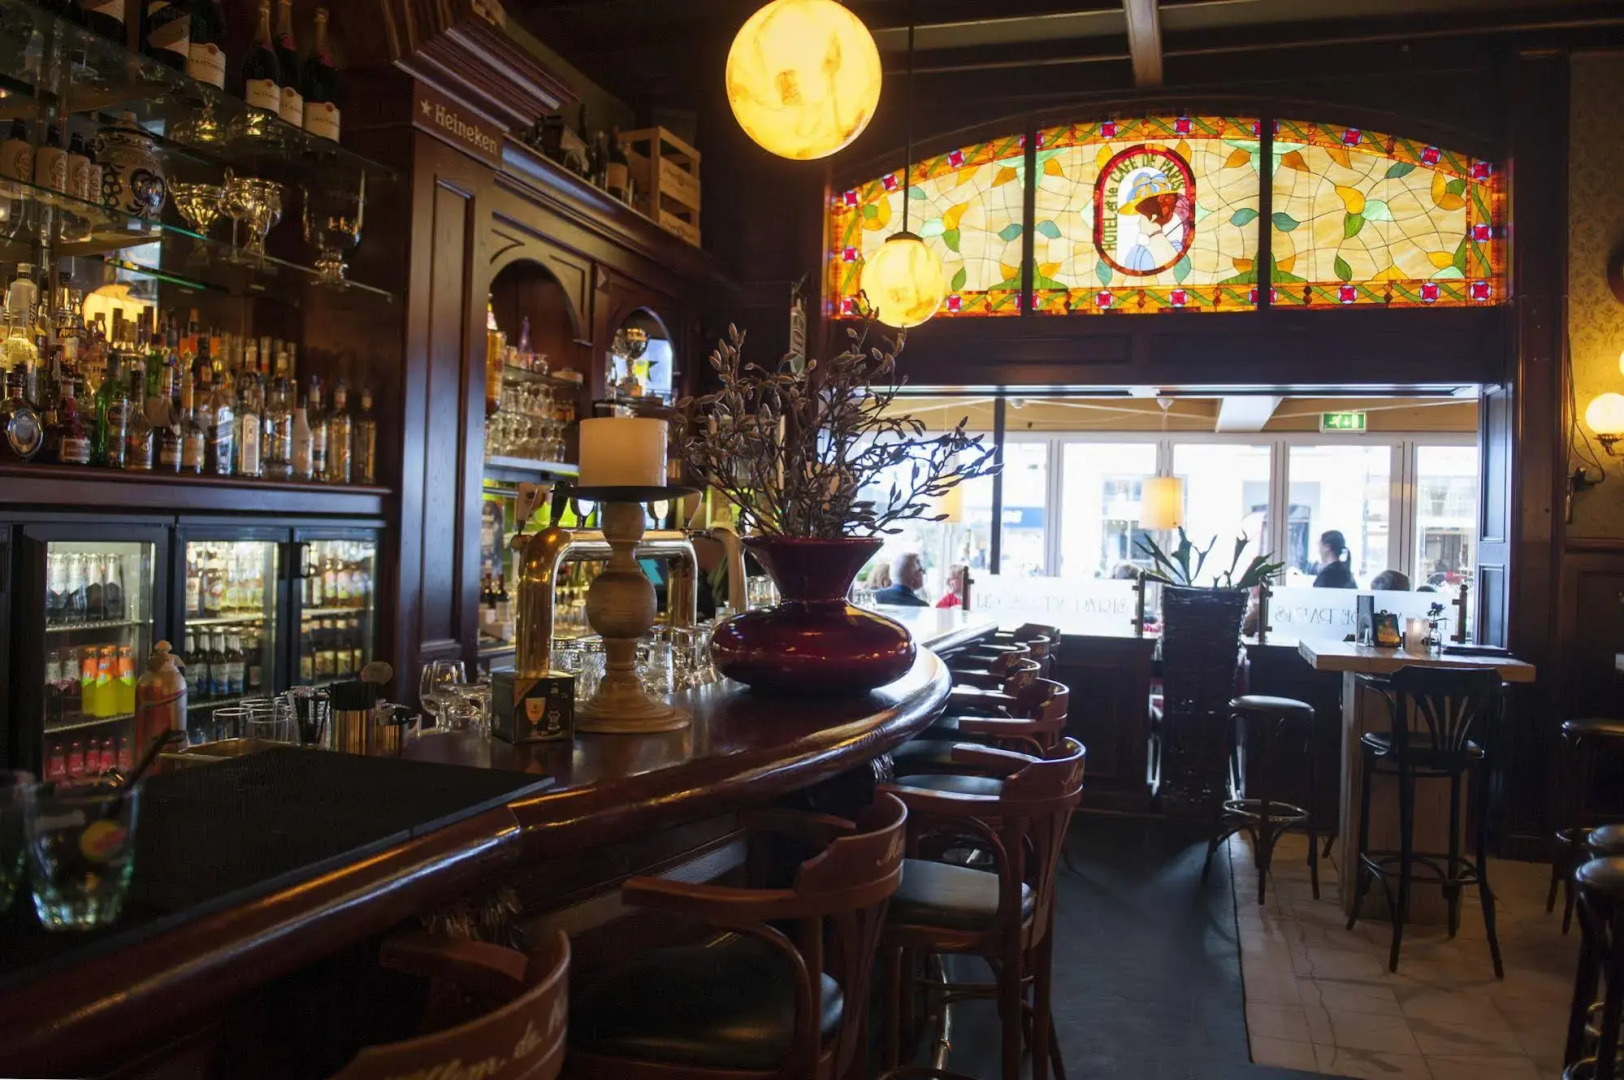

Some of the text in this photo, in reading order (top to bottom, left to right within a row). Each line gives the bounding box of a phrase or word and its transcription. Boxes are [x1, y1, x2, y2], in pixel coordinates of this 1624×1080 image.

[434, 104, 497, 155] Heineken
[1102, 213, 1118, 250] HOTEL
[1142, 153, 1157, 167] DE
[1159, 159, 1185, 191] PARIS
